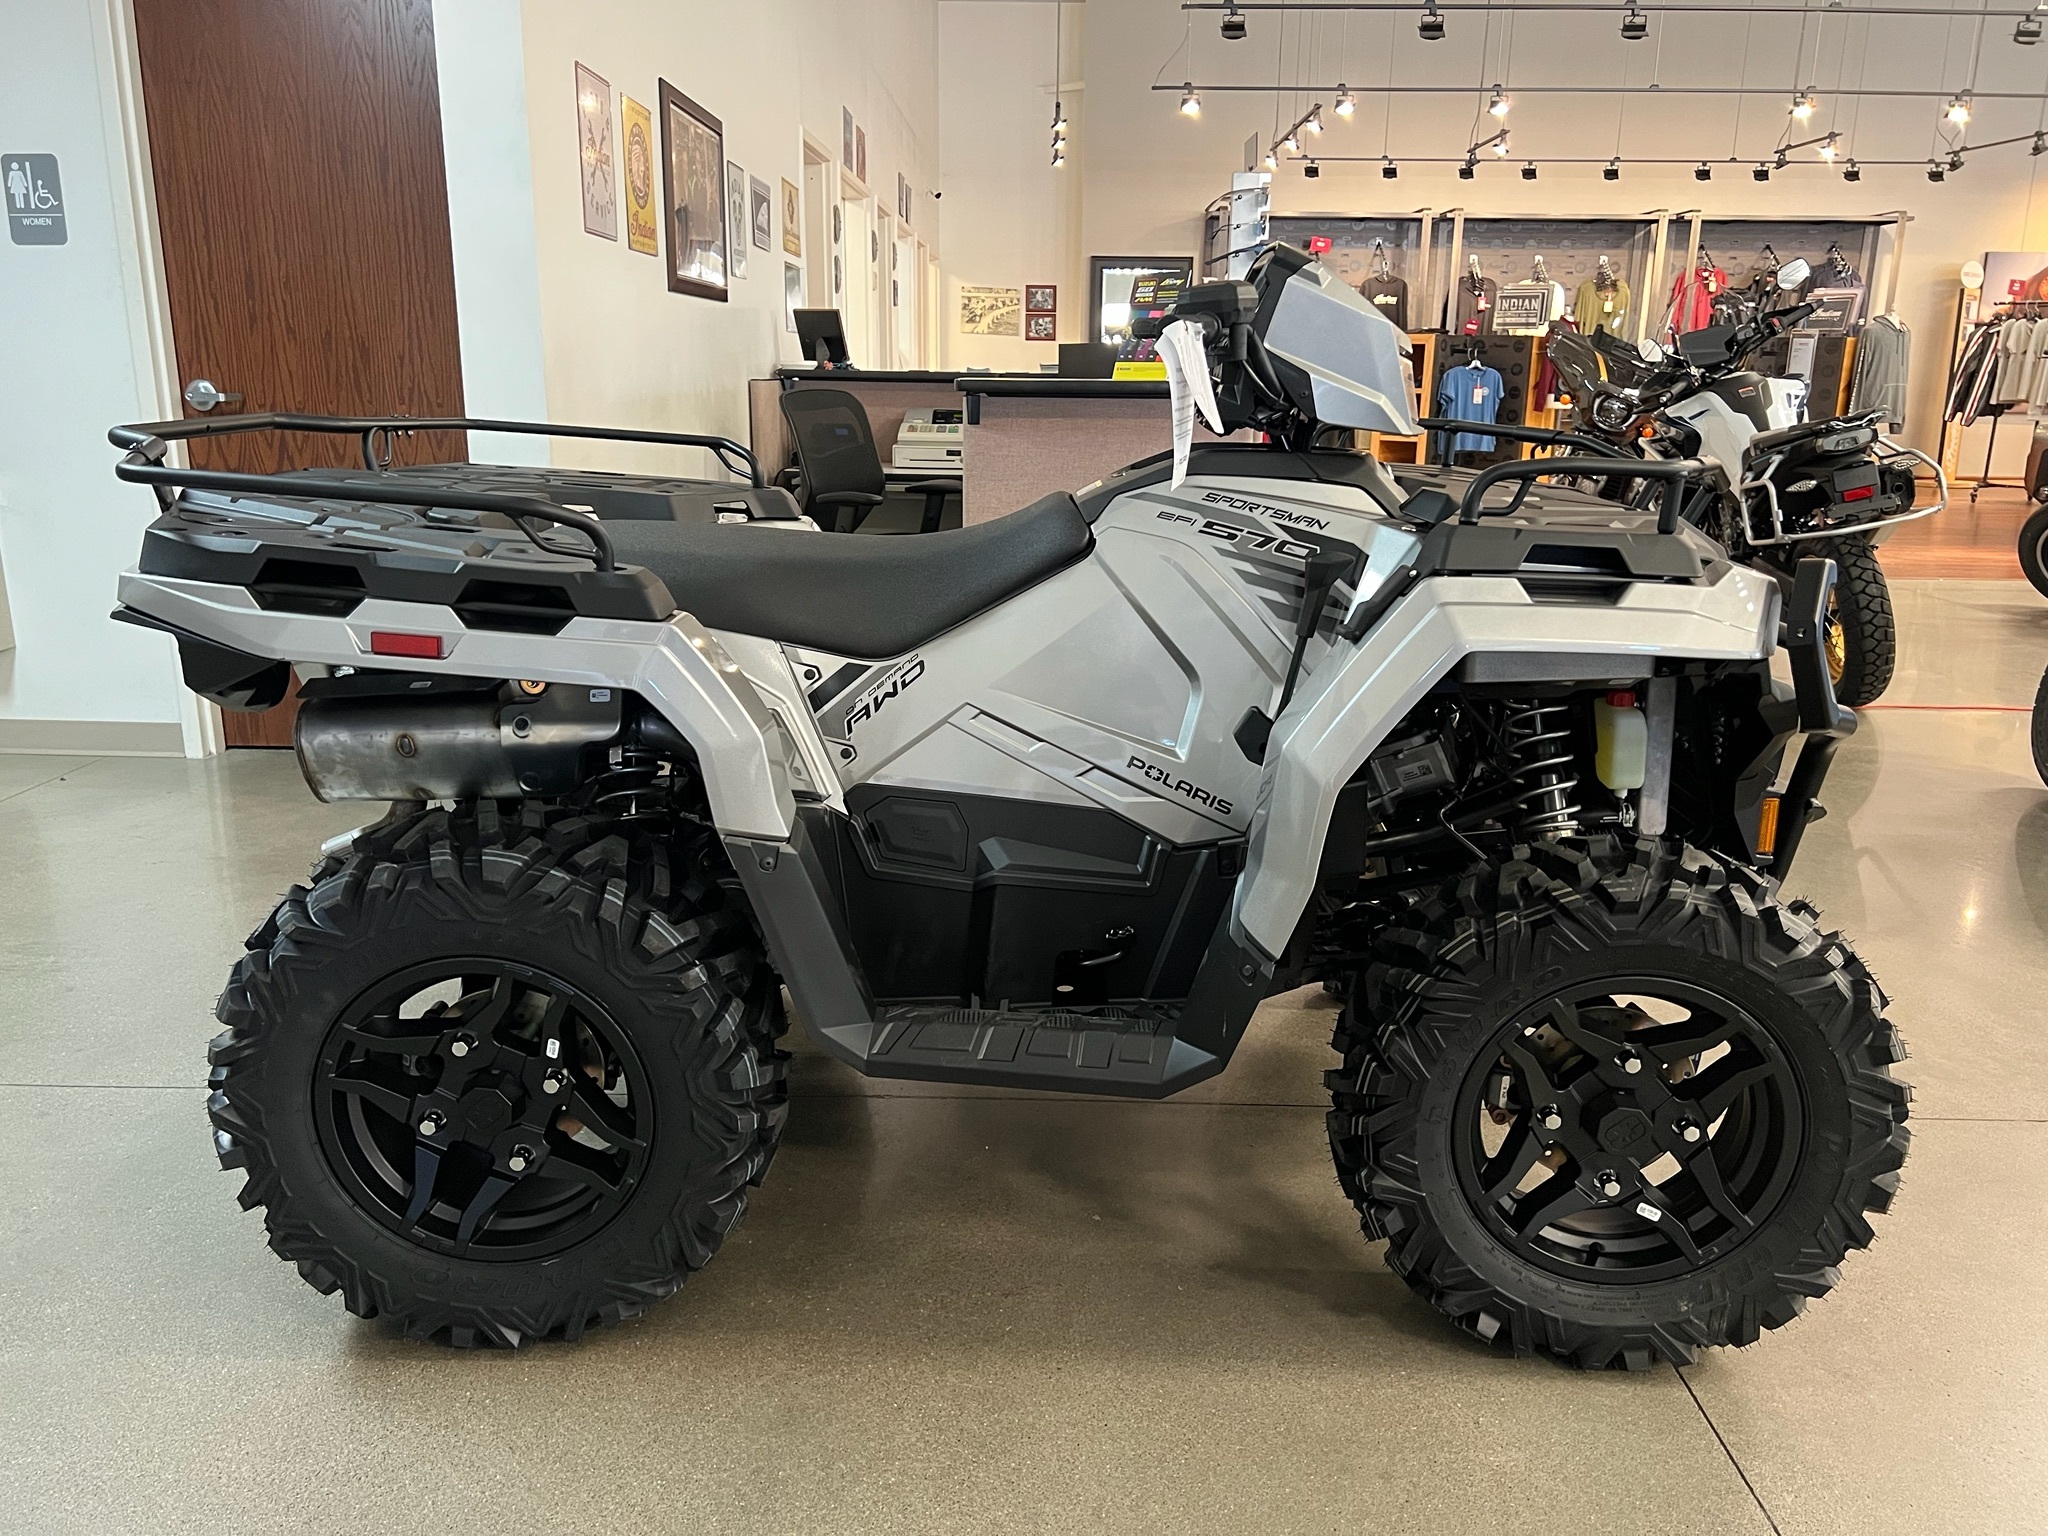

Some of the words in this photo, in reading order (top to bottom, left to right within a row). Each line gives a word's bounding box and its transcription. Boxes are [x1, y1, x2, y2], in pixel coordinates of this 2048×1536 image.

[22, 217, 52, 226] WOMEN
[631, 210, 656, 242] Indian
[1498, 298, 1539, 311] INDIAN
[1201, 491, 1330, 530] SPORTSMAN
[1156, 511, 1198, 526] EFI
[1197, 518, 1320, 562] 570
[845, 659, 926, 737] AWD
[1126, 755, 1234, 816] POLARIS
